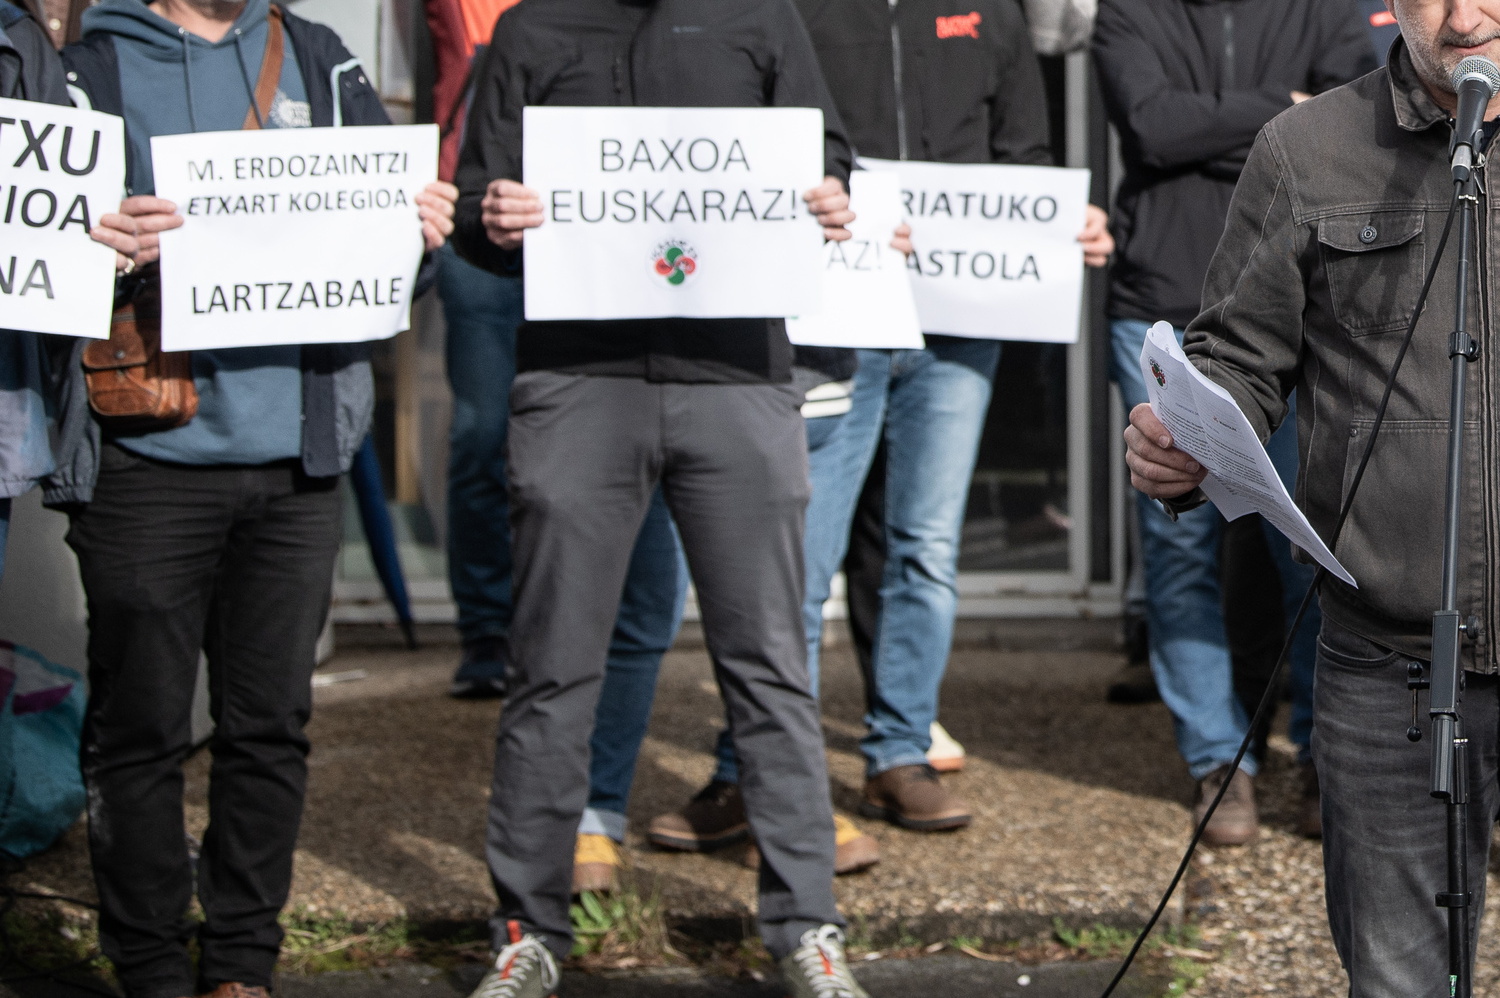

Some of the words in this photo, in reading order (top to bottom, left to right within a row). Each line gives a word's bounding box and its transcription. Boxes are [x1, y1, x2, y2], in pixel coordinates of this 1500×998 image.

[187, 160, 223, 182] M.
[235, 152, 409, 181] ERDOZAINTZI
[600, 138, 751, 173] BAXOA
[187, 193, 279, 216] ETXART
[289, 188, 408, 211] KOLEGIOA
[552, 189, 798, 223] EUSKARAZ!
[192, 277, 403, 314] LARTZABALE
